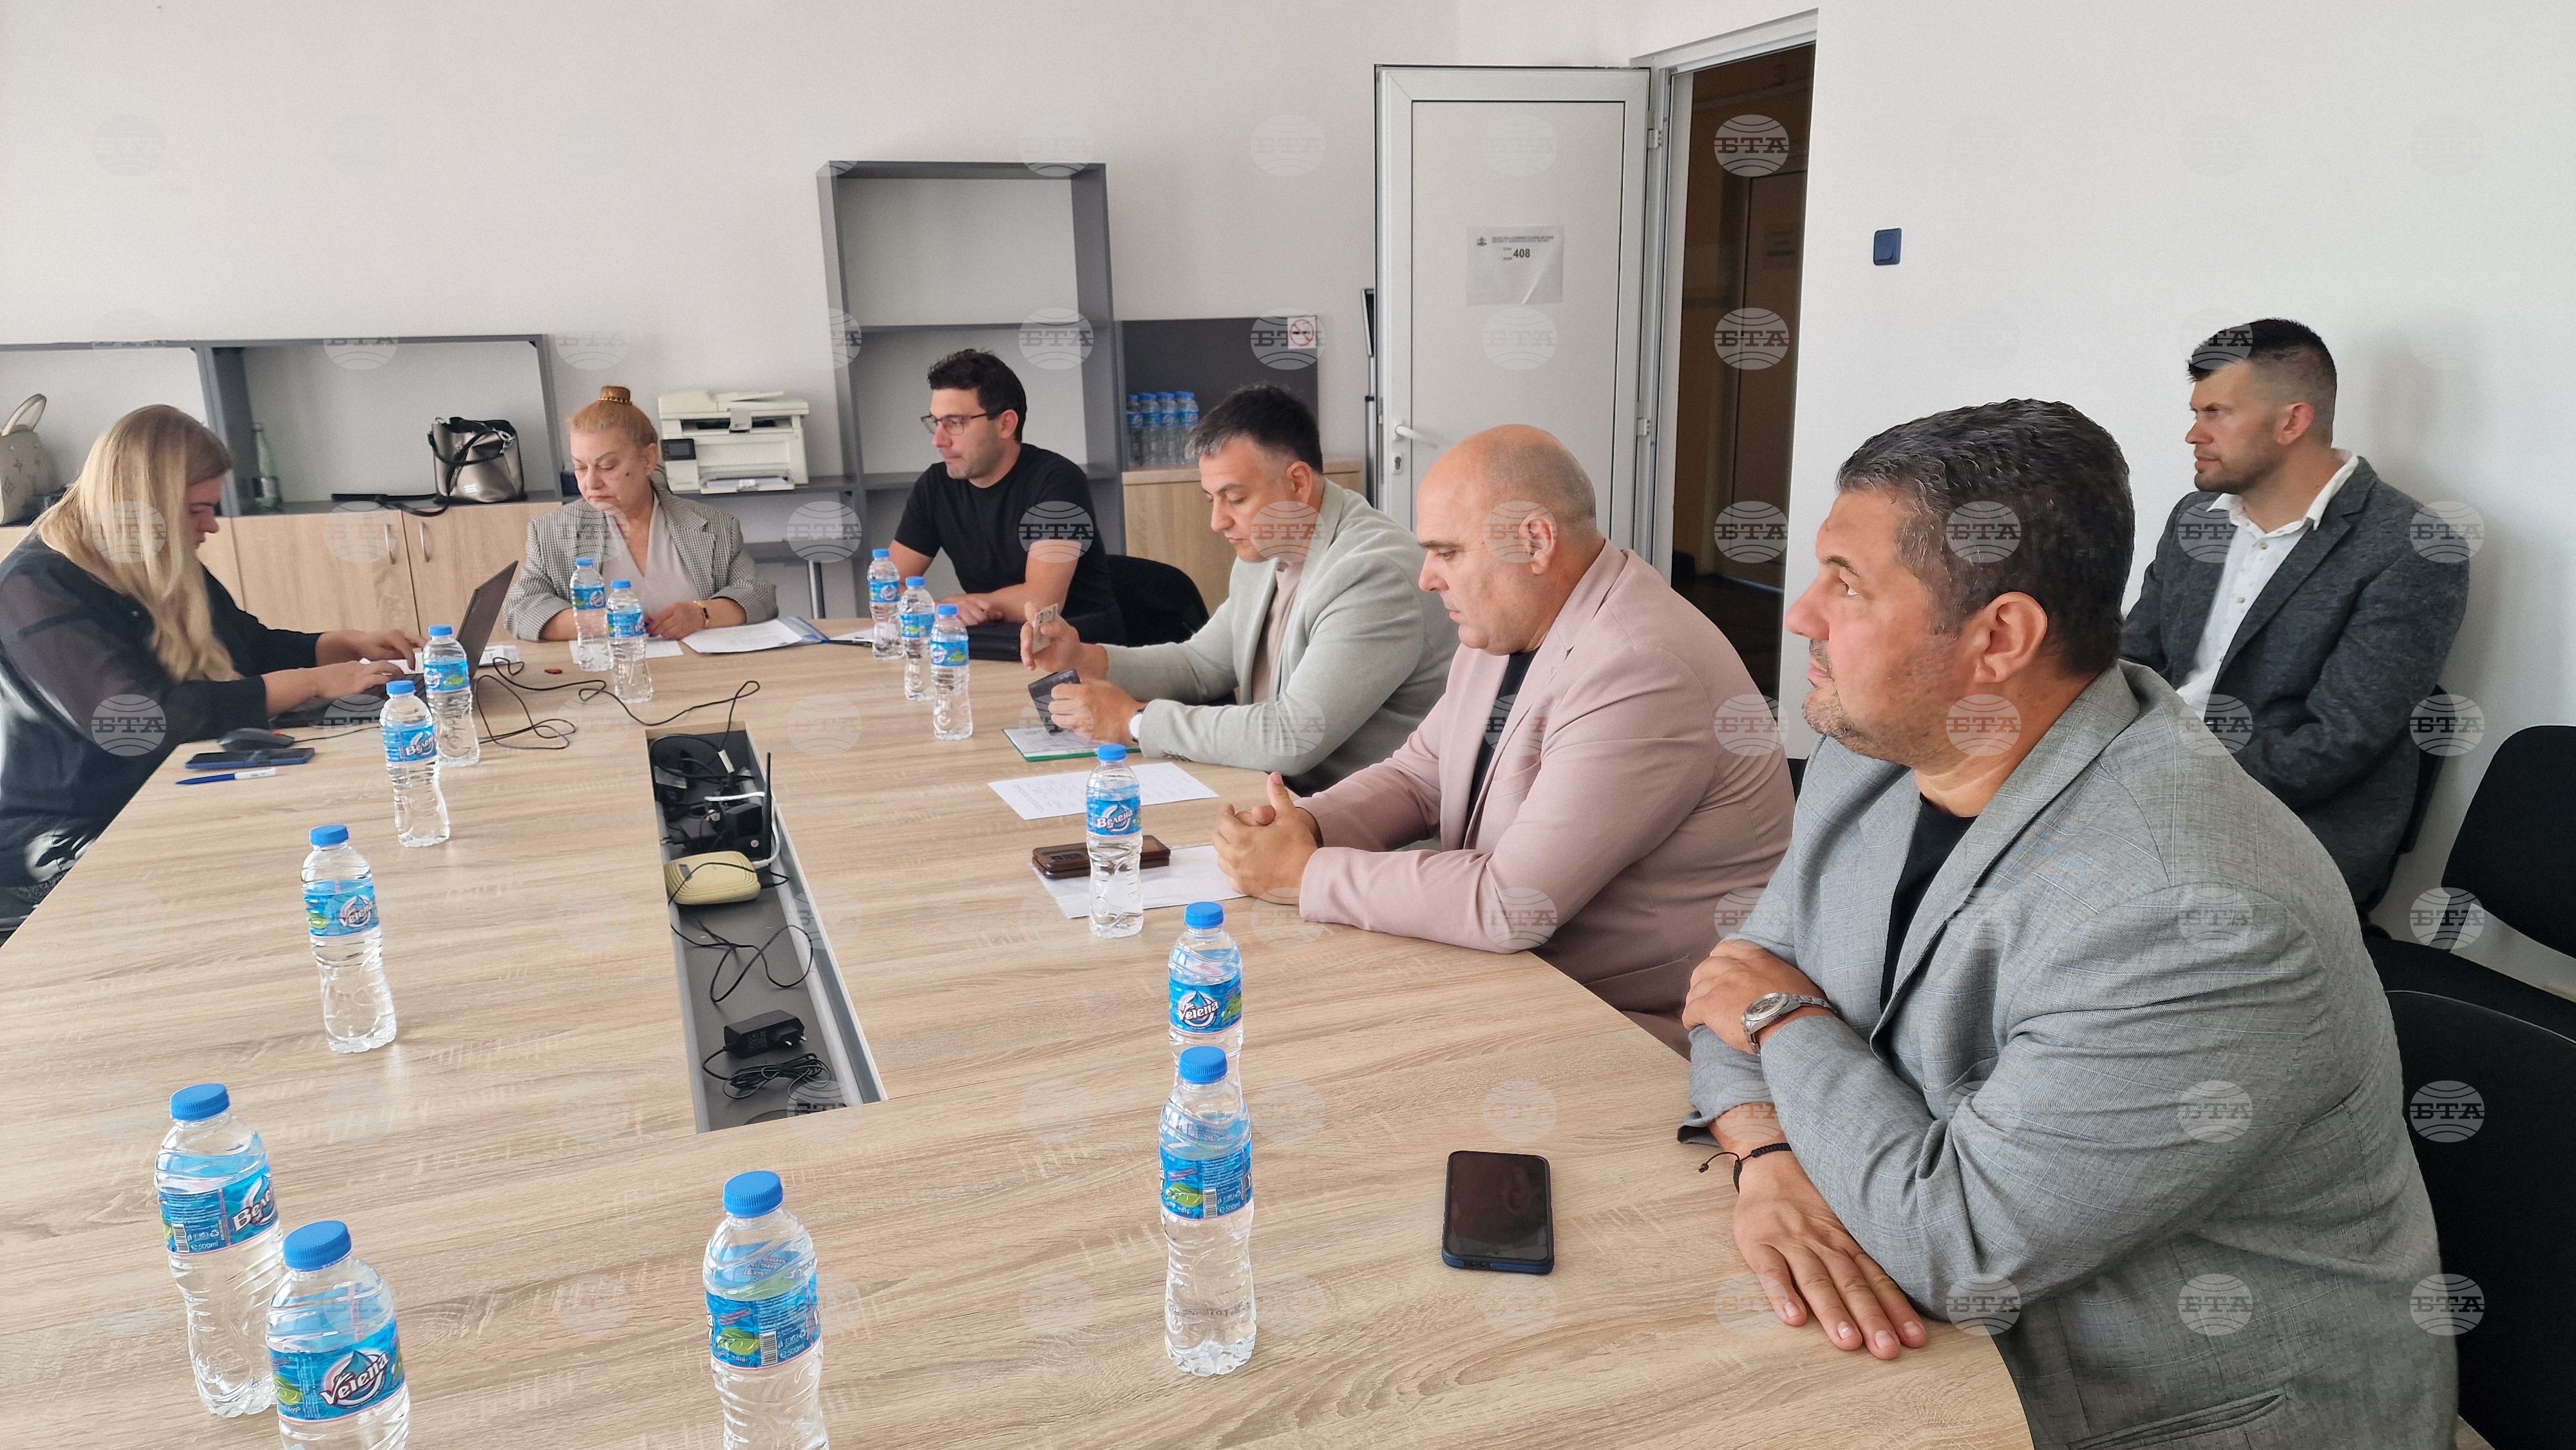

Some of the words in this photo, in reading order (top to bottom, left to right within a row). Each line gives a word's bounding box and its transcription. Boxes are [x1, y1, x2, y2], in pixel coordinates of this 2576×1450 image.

[1513, 249, 1530, 258] 408
[1177, 1000, 1220, 1021] Velena
[319, 1351, 389, 1405] Velena
